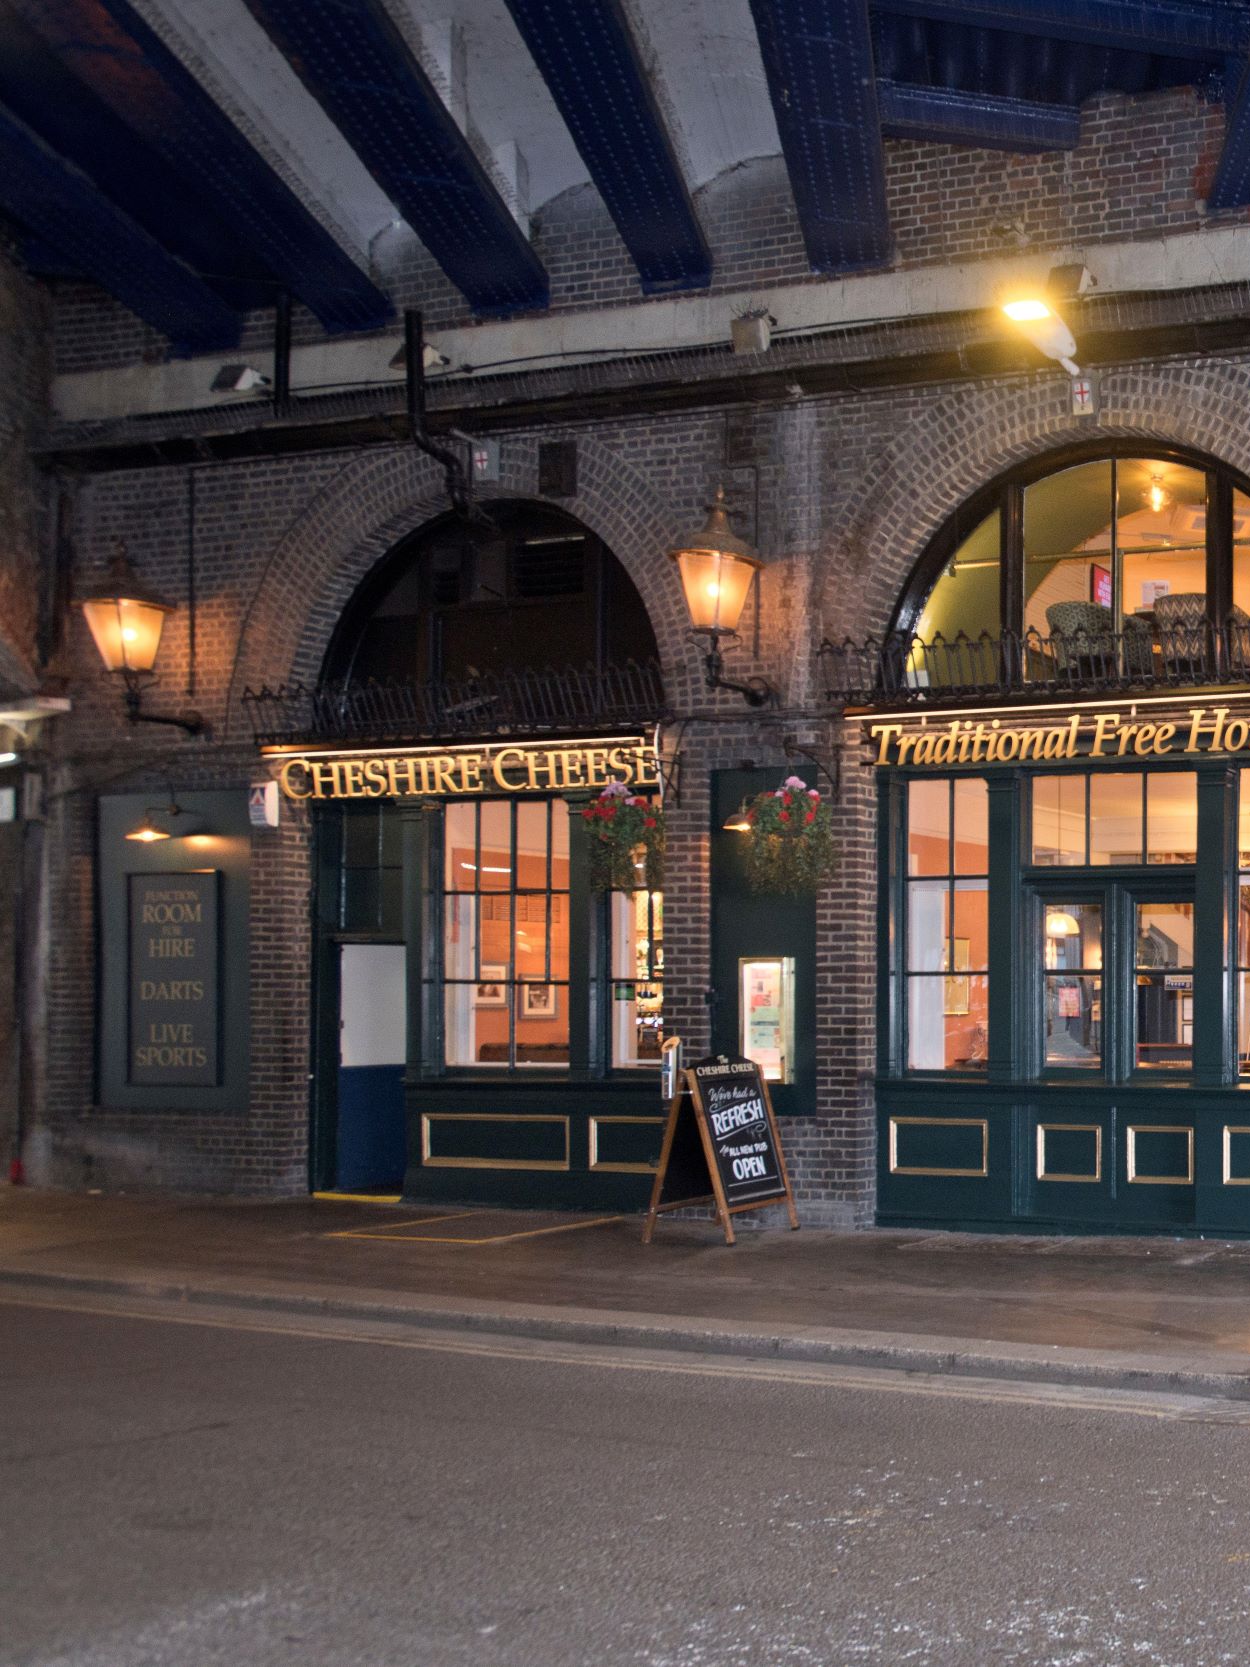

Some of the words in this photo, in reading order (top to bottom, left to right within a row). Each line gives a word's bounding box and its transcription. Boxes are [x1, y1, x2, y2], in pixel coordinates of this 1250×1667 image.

[870, 715, 1080, 766] Traditional
[1088, 713, 1176, 757] Free
[281, 755, 484, 799] CHESHIRE
[493, 745, 659, 790] CHEESE
[142, 903, 202, 924] ROOM
[149, 938, 195, 958] HIRE
[141, 981, 204, 1000] DARTS
[151, 1024, 194, 1043] LIVE
[135, 1048, 207, 1067] SPORTS
[696, 1065, 730, 1076] CHESHIRE
[731, 1063, 754, 1073] CHEESE
[732, 1085, 748, 1099] had
[711, 1099, 763, 1136] REFRESH
[732, 1156, 766, 1179] OPEN
